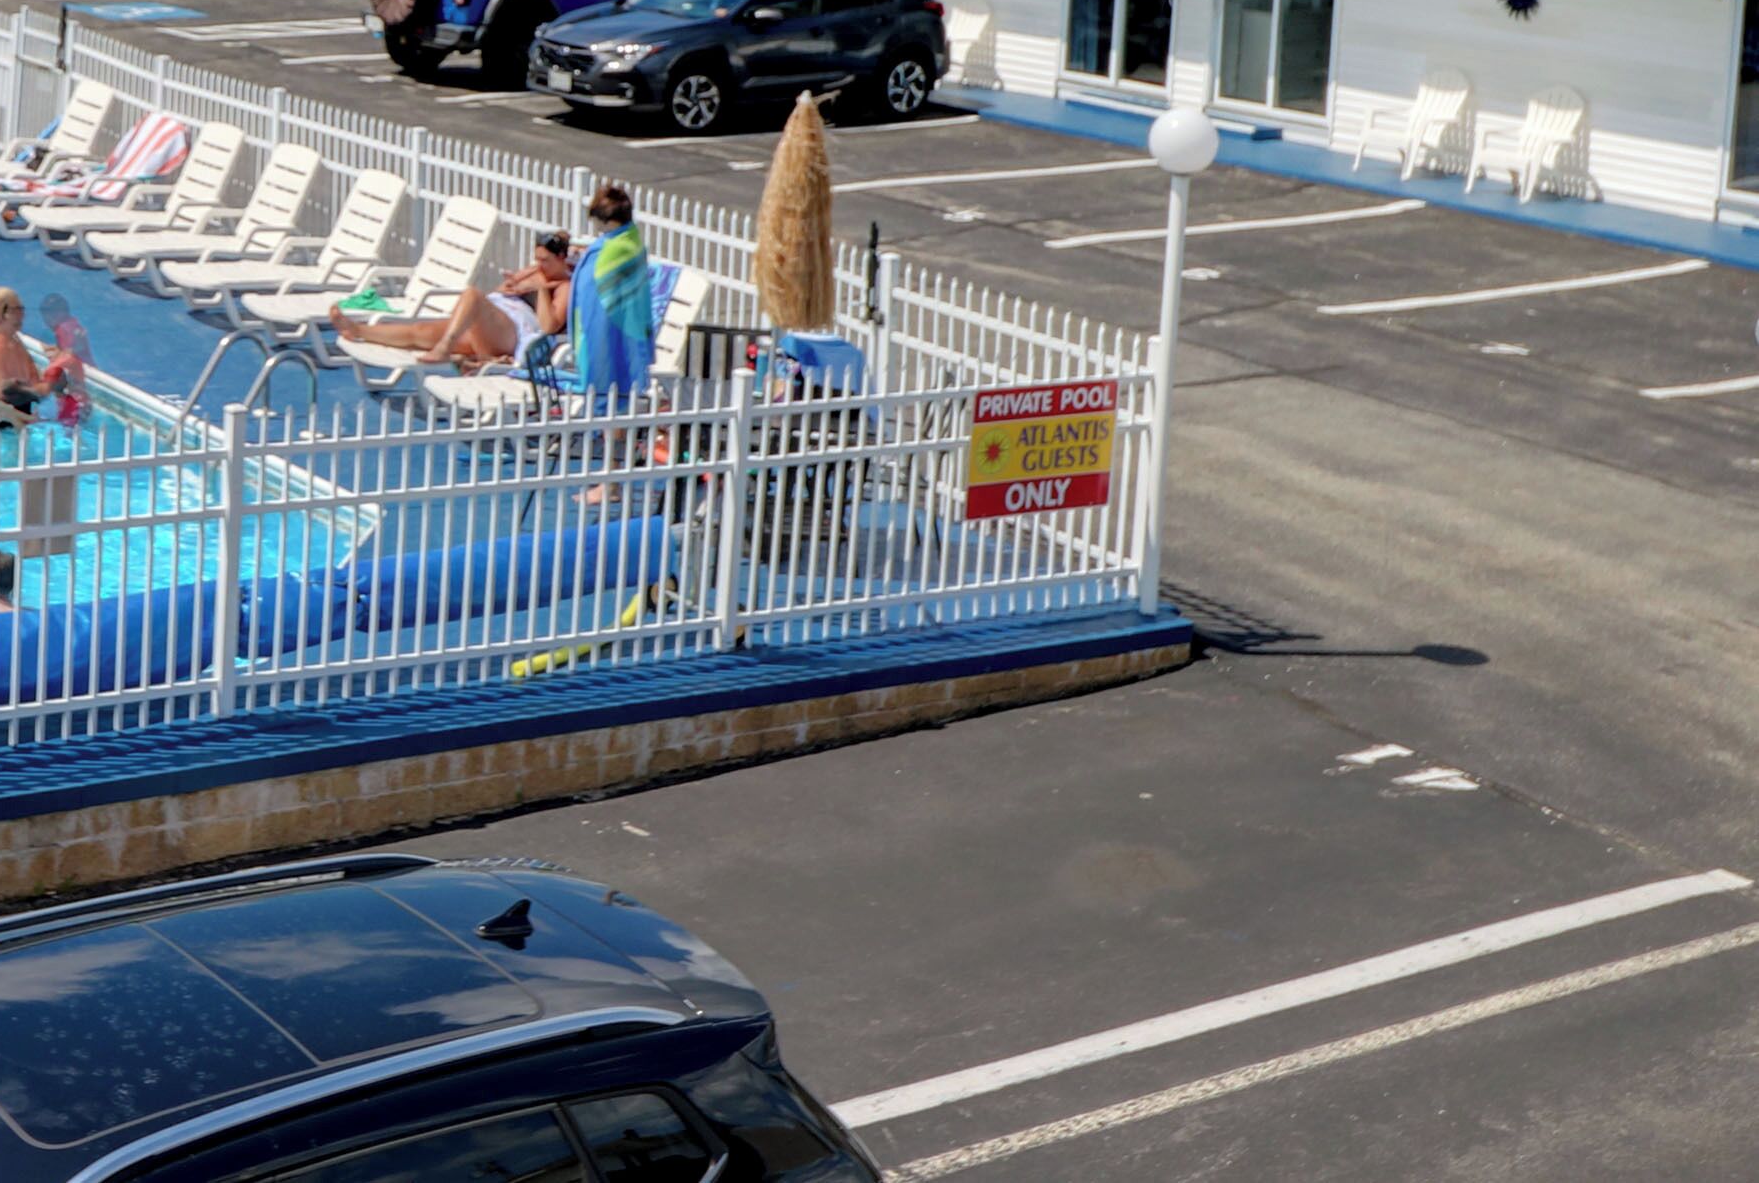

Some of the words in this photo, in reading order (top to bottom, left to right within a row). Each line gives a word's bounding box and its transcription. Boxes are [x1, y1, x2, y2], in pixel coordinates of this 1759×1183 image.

[978, 390, 1054, 418] PRIVATE
[1059, 385, 1113, 411] POOL
[1016, 418, 1110, 448] ATLANTIS
[1021, 444, 1099, 472] GUESTS
[1005, 477, 1072, 512] ONLY
